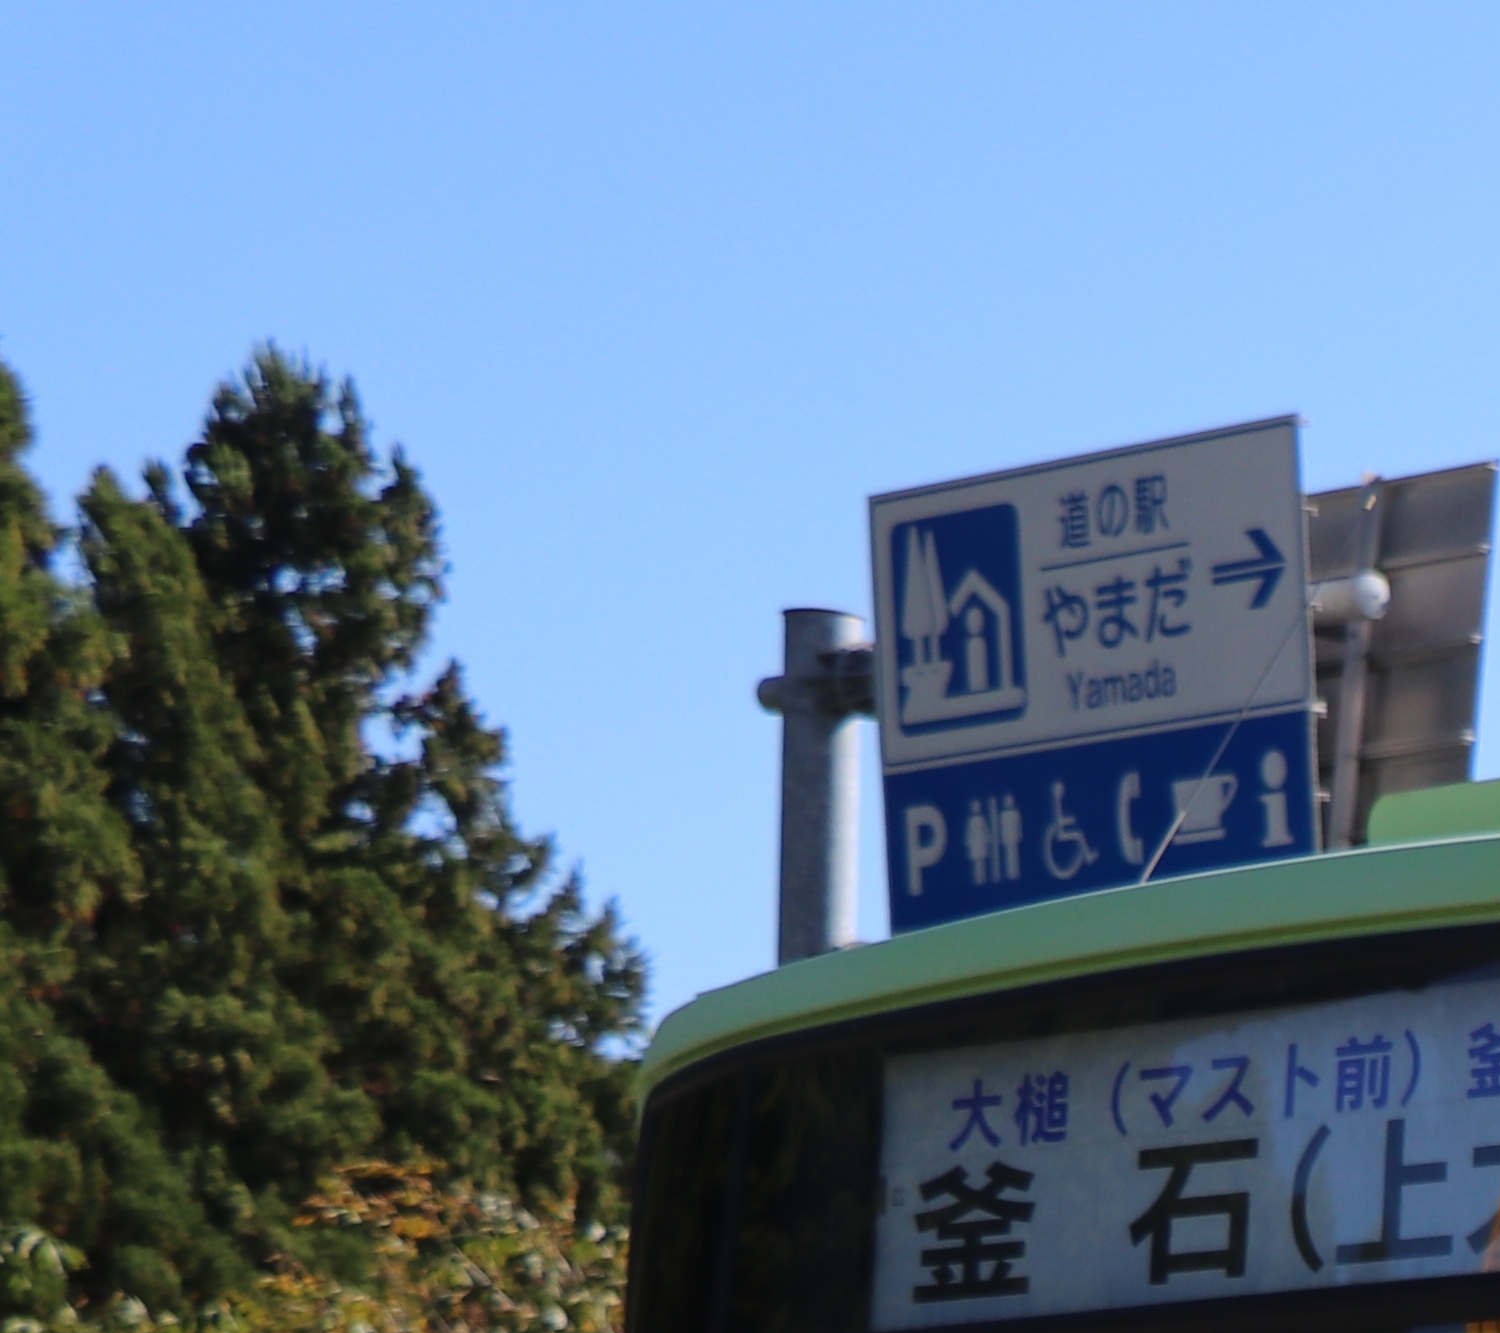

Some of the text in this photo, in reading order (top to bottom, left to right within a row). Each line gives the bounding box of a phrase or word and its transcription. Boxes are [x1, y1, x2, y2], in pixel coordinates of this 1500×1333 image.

[1057, 473, 1170, 549] 道の駅
[1042, 556, 1193, 659] やまだ
[1066, 660, 1178, 711] Yamada
